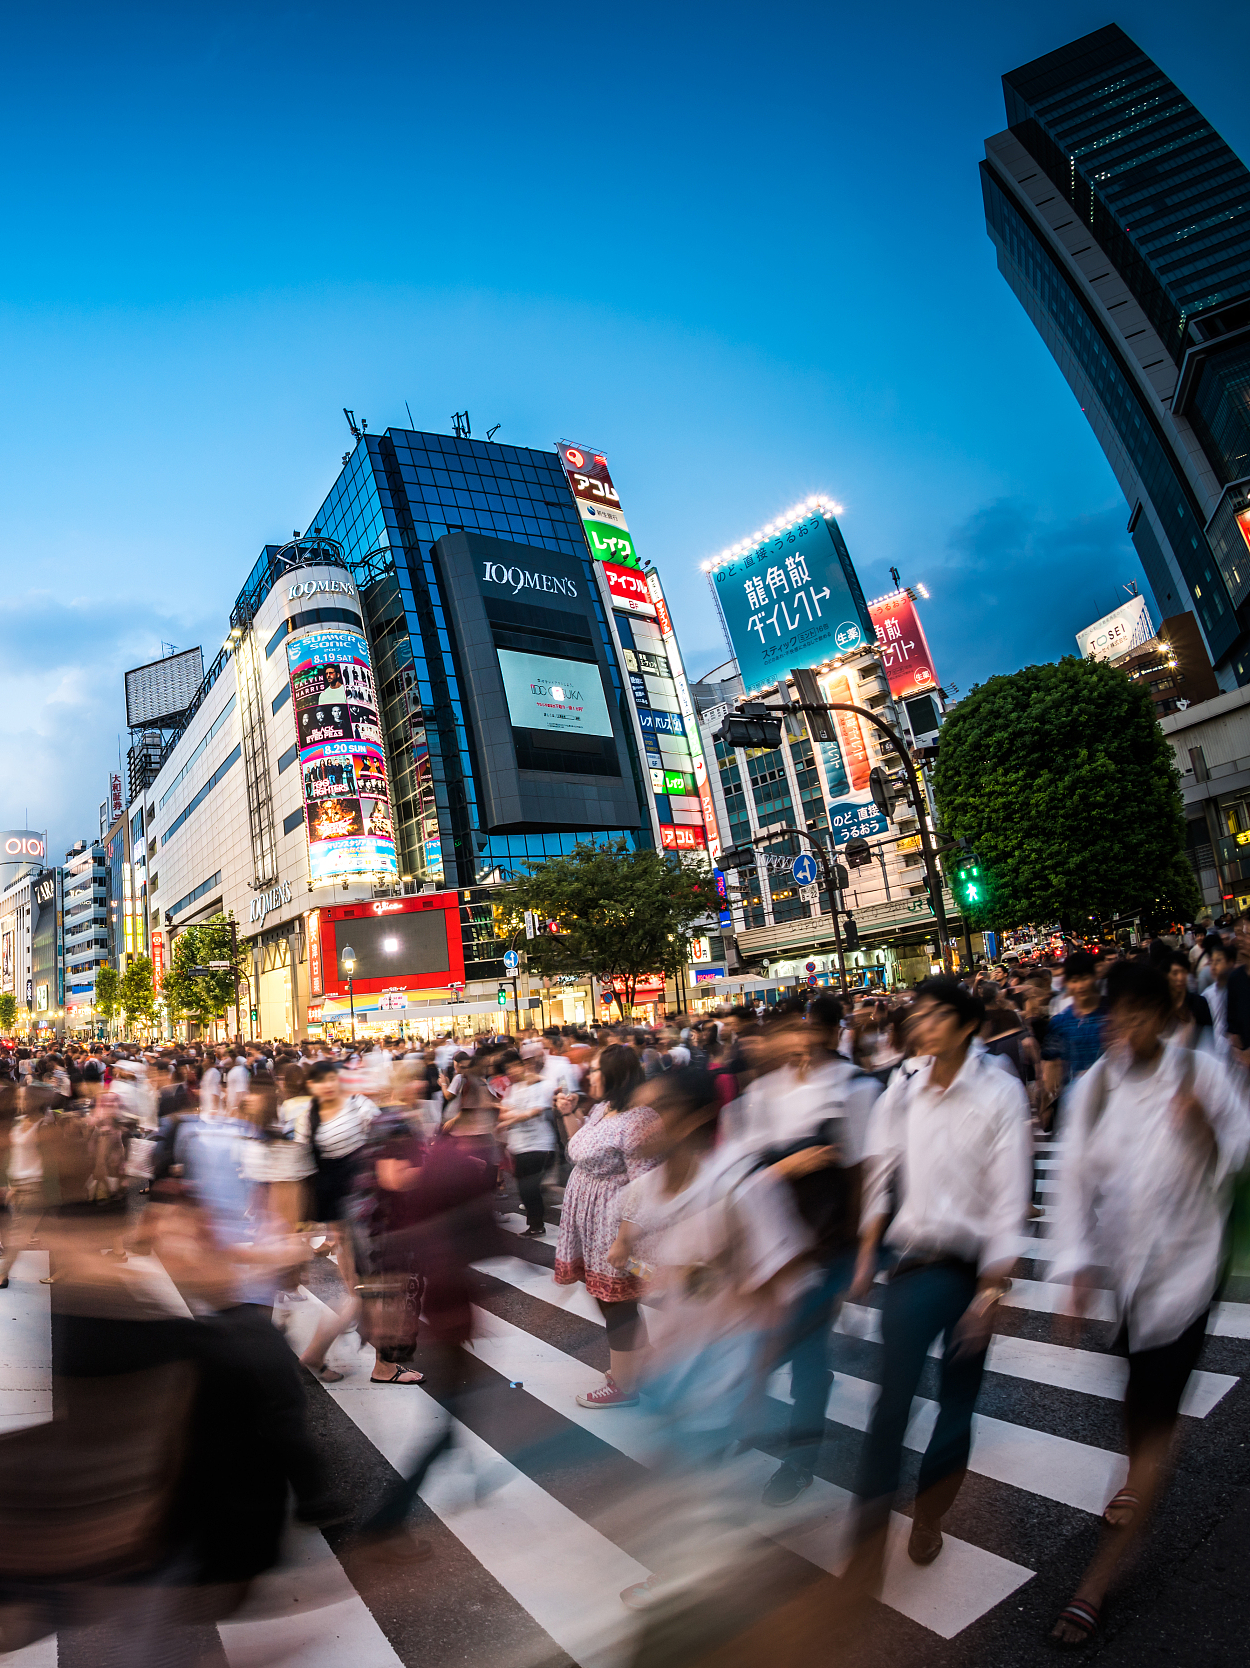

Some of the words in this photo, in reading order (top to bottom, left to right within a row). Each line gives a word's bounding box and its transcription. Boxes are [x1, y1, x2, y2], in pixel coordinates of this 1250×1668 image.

[573, 473, 620, 501] アコム
[591, 531, 631, 556] レイク
[716, 517, 820, 583] のど、直接、うるおう
[605, 571, 648, 594] アイフル
[743, 551, 812, 611] 龍角散
[747, 586, 831, 644] ダイレクト
[303, 635, 356, 646] SUMMER
[836, 626, 861, 645] 生薬
[310, 641, 352, 651] SONIC
[761, 636, 797, 660] スティック
[313, 653, 336, 664] 8.19
[337, 654, 352, 662] SAT
[294, 675, 325, 690] CALVIN
[295, 684, 326, 699] HARRIS
[325, 743, 347, 755] 8.20
[349, 745, 367, 753] SUN
[312, 778, 330, 789] FOO
[666, 777, 685, 789] レイク
[111, 774, 123, 811] 大和証券
[313, 784, 350, 798] FIGHTERS
[664, 830, 695, 844] アコム
[841, 820, 880, 841] うるおう
[907, 899, 923, 911] JR
[697, 973, 715, 982] PROMISE
